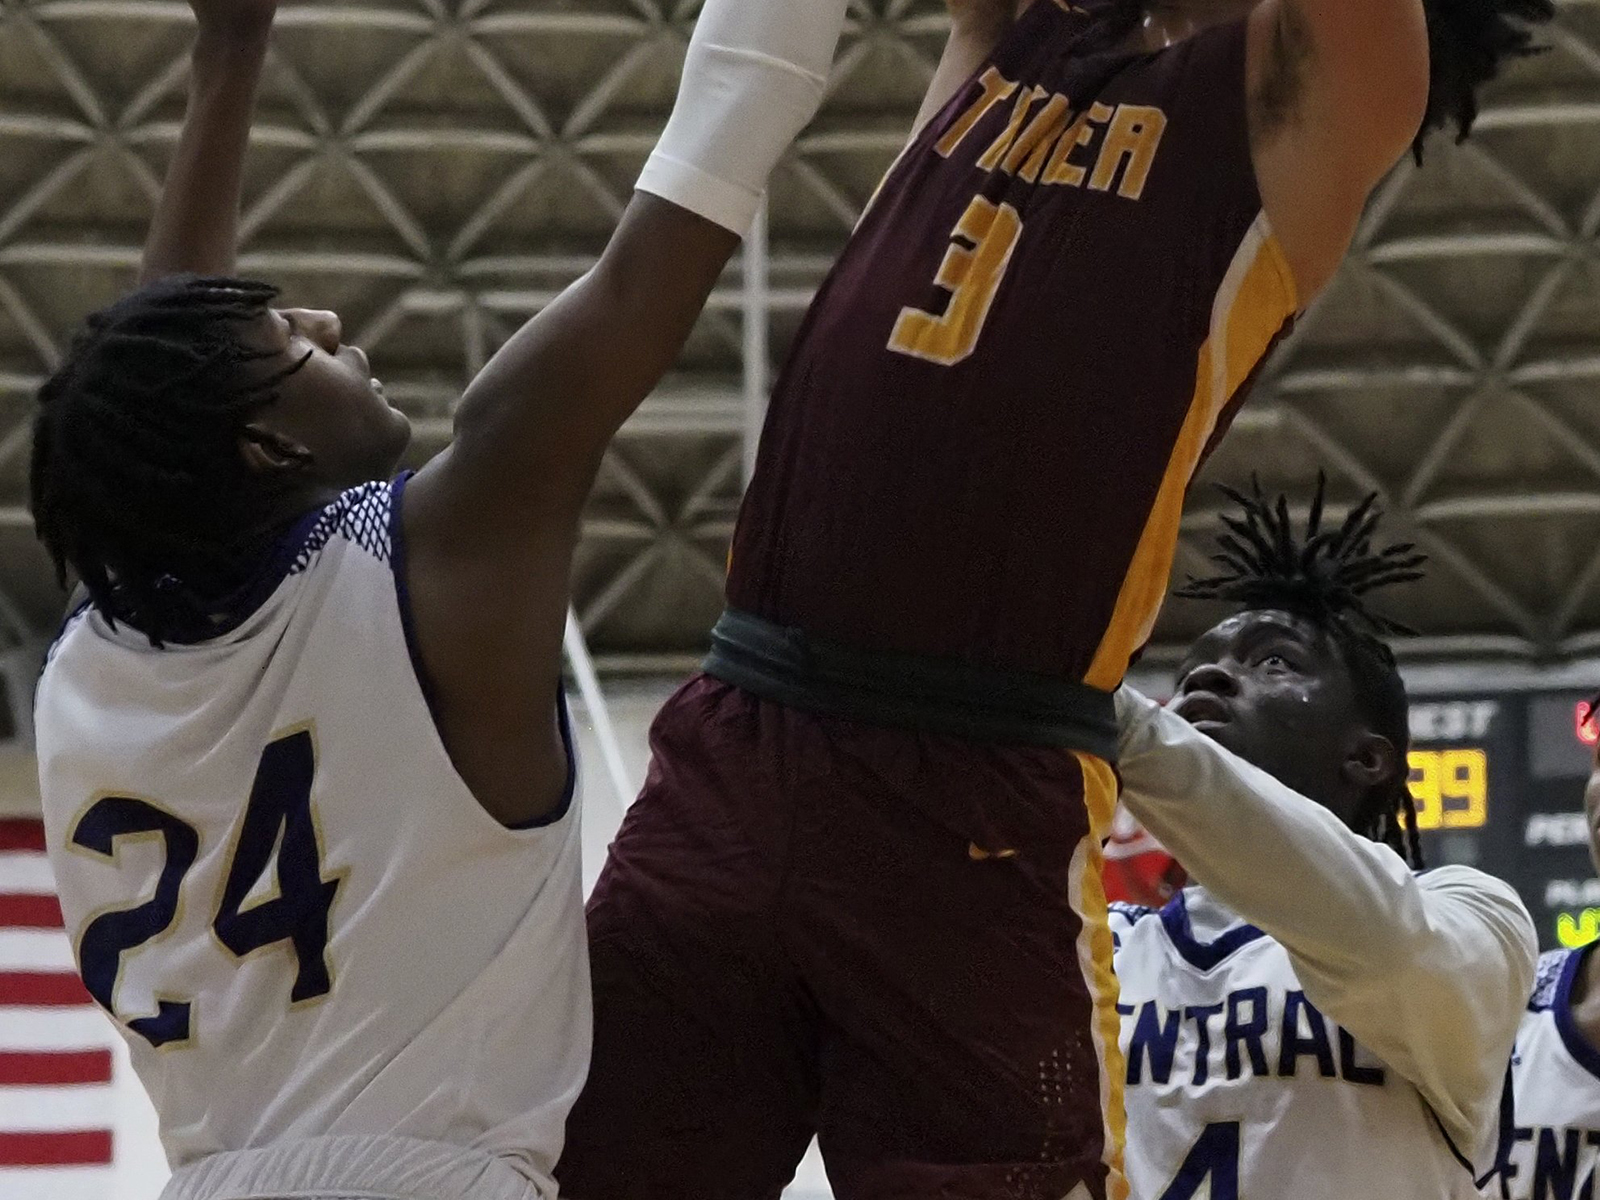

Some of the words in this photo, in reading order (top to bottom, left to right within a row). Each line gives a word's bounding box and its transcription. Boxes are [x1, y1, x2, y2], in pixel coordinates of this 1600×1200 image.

[886, 193, 1025, 366] 3
[66, 717, 351, 1054] 24
[1116, 985, 1385, 1087] NTRAL
